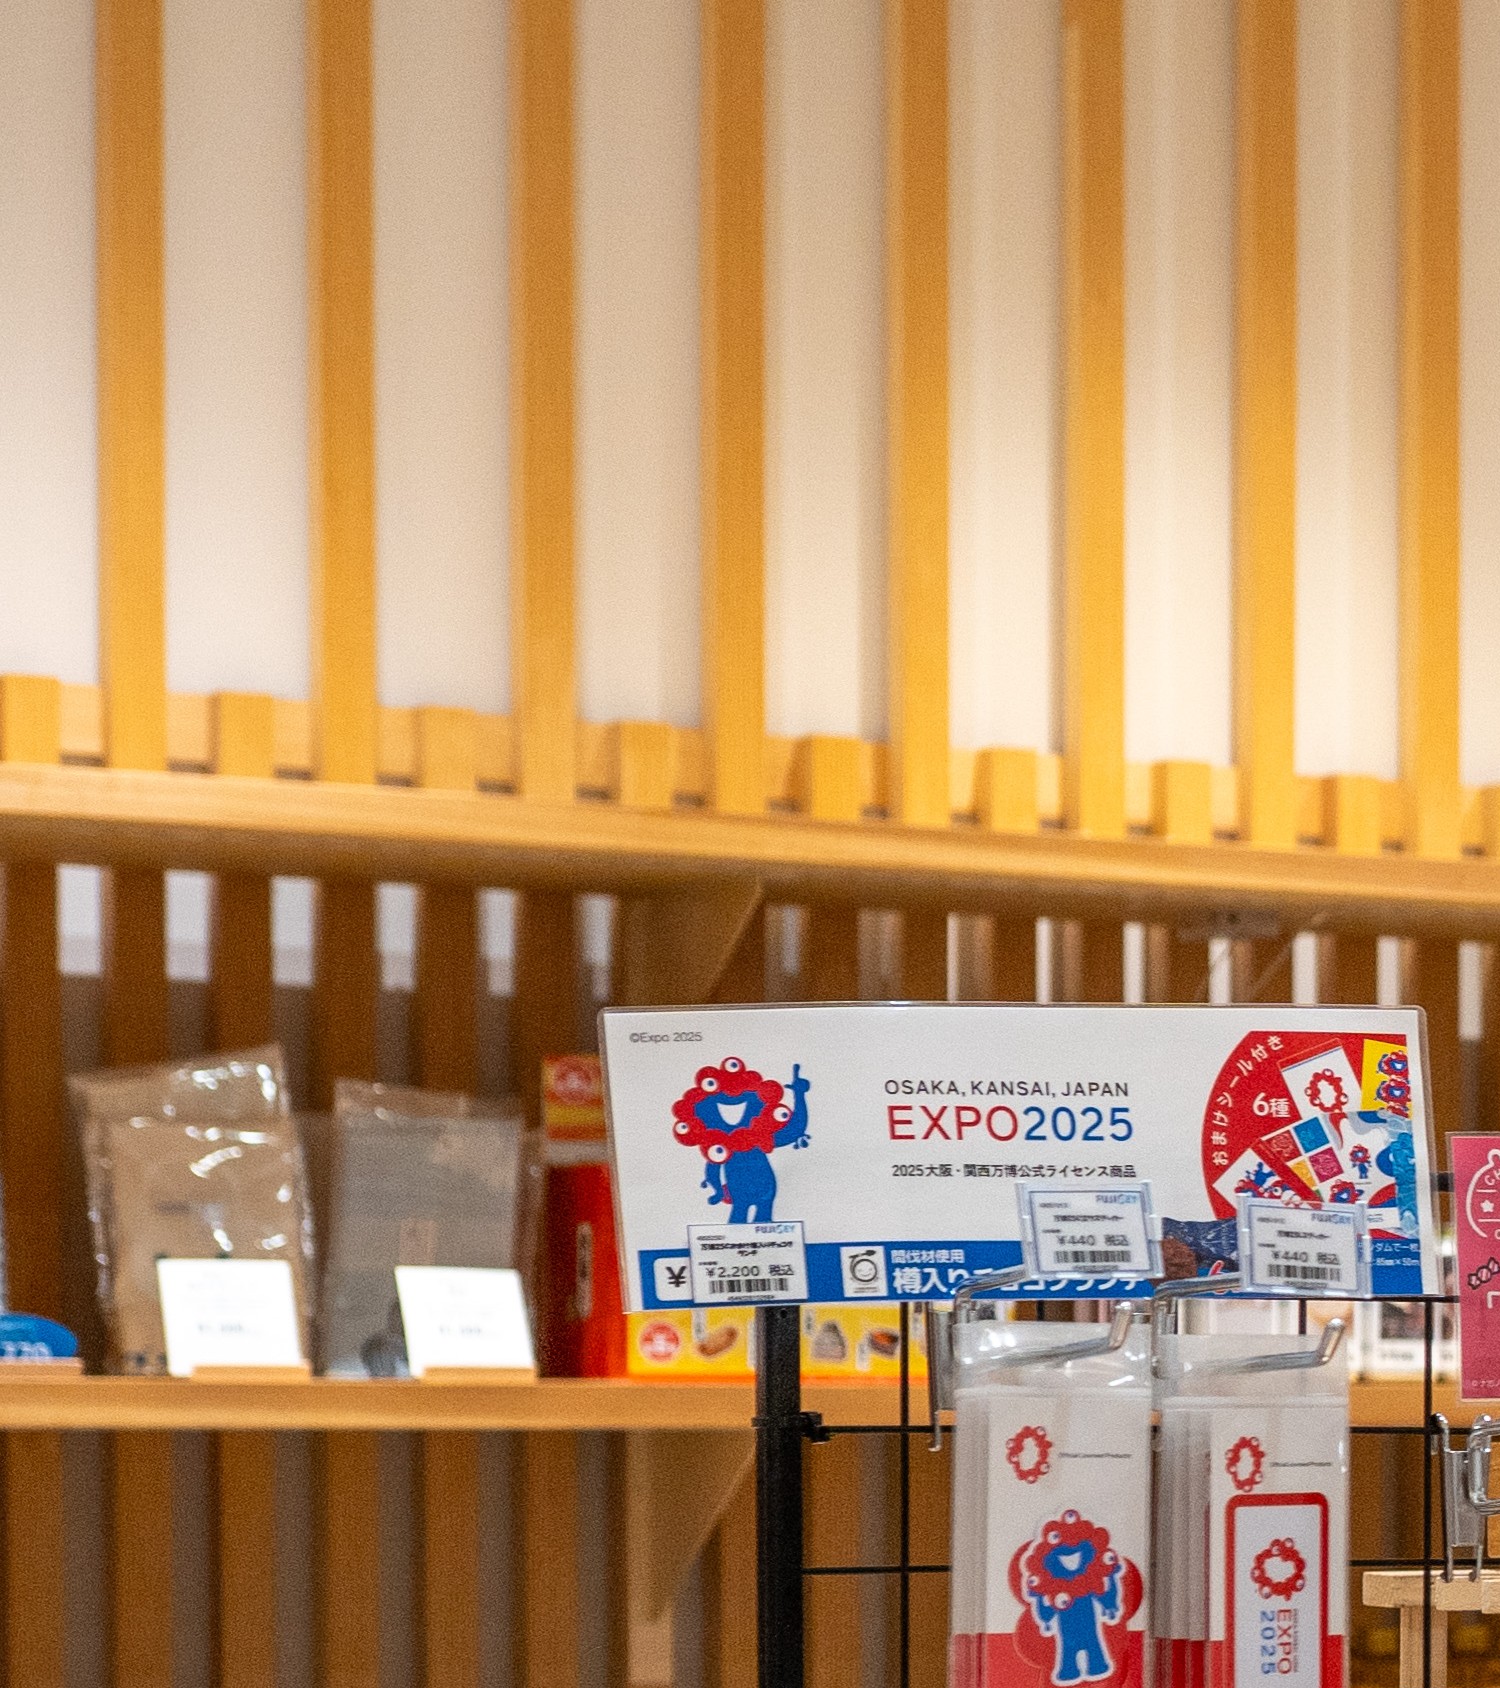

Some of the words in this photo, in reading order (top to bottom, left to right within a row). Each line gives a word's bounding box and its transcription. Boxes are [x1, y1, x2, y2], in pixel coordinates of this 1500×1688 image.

[673, 1032, 702, 1042] 2025
[884, 1080, 966, 1096] OSAKA,
[971, 1081, 1056, 1097] KANSAI,
[1061, 1082, 1129, 1096] JAPAN
[1210, 1034, 1284, 1165] おまけシール付き
[1252, 1093, 1291, 1118] 6種
[887, 1105, 1134, 1142] EXPO2025
[892, 1164, 1137, 1178] 2025大阪・関西万博公式ライセンス商品
[1261, 1610, 1276, 1675] 2025
[1277, 1609, 1292, 1674] EXPO
